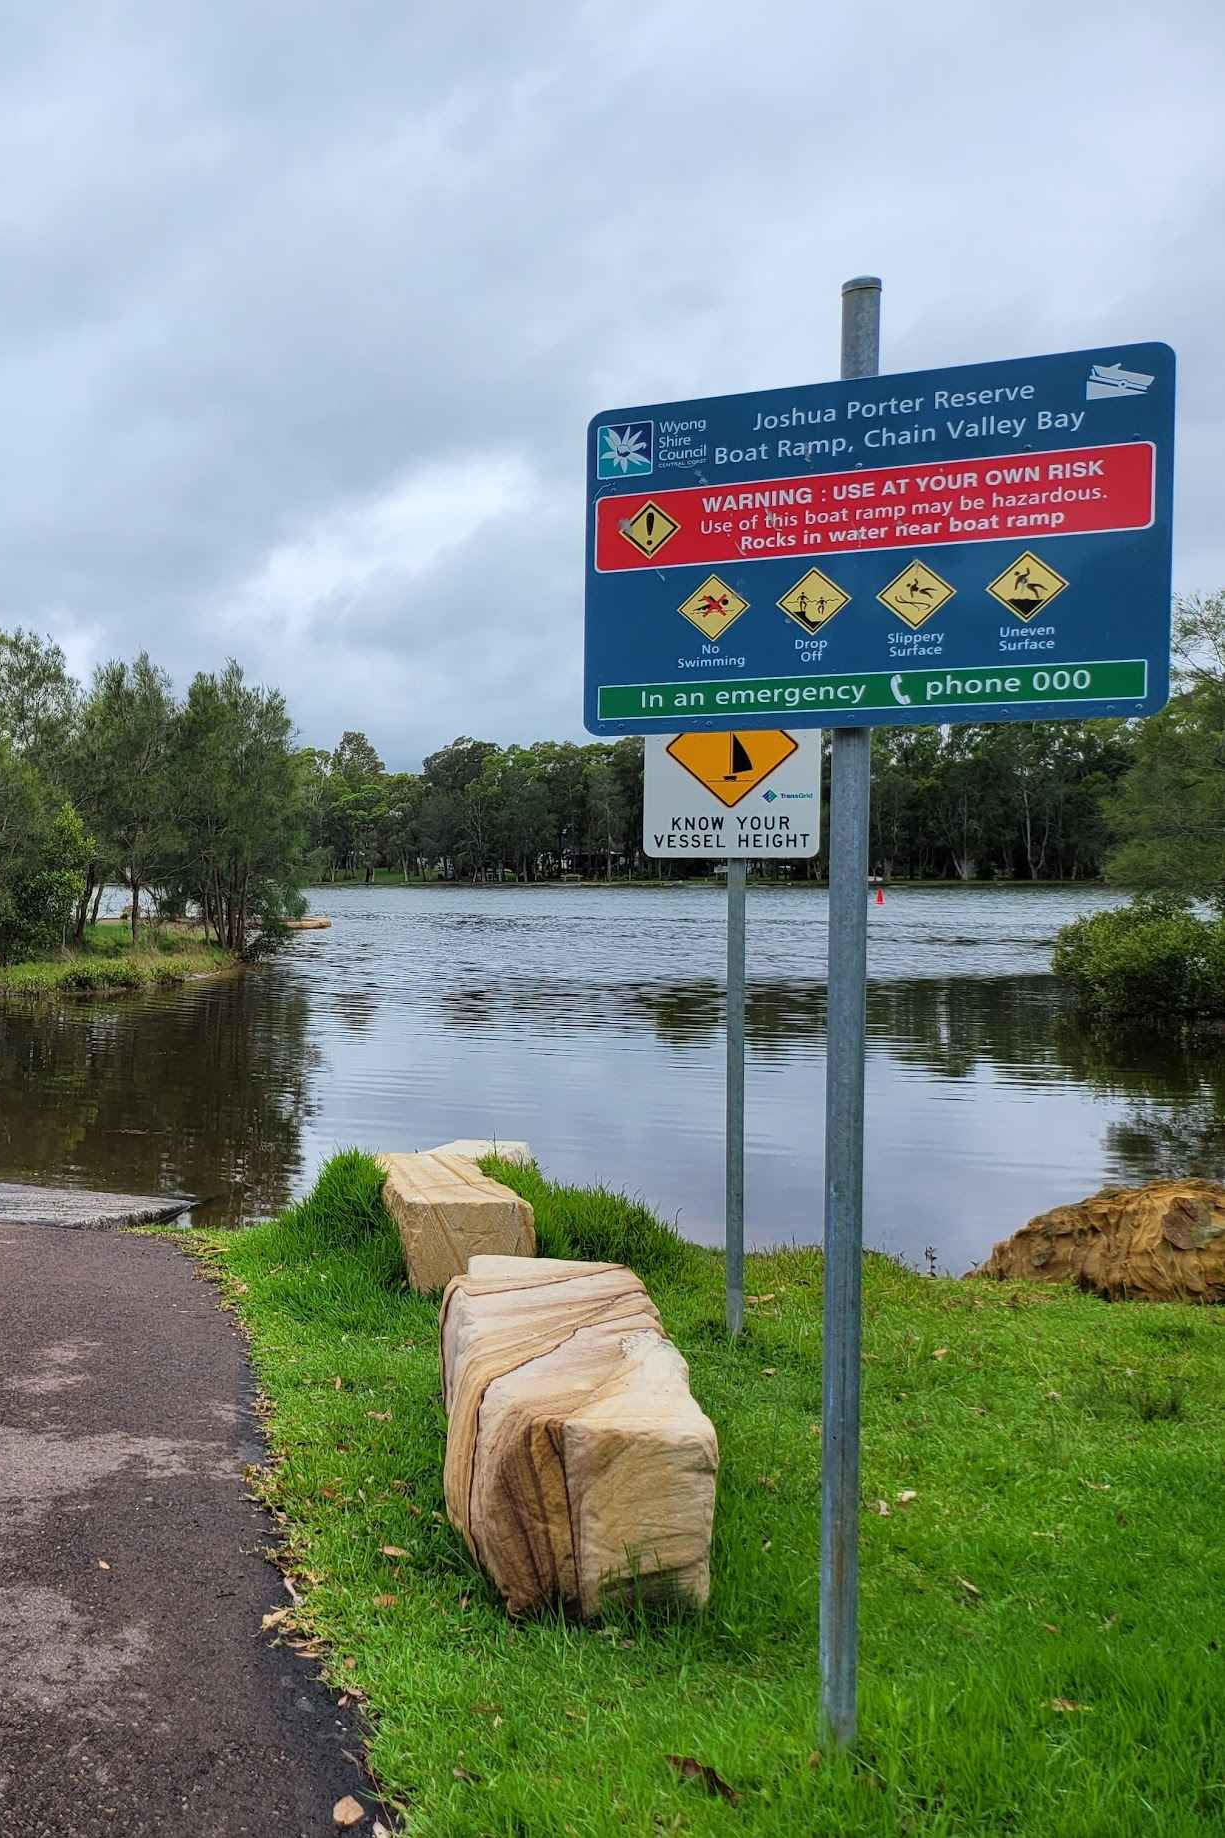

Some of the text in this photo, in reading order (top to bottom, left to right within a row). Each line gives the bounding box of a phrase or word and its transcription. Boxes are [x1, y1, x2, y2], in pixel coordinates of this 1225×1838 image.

[752, 384, 1035, 430] Joshua Porter Reserve
[658, 419, 707, 434] Wyong
[658, 435, 691, 448] Shire
[714, 410, 1085, 465] Boat Ramp, Chain Valley Bay
[658, 444, 707, 461] Council
[702, 487, 813, 513] WARNING
[832, 482, 876, 501] USE
[881, 479, 910, 496] AT
[915, 472, 978, 493] YOUR
[984, 466, 1040, 486] OWN
[1048, 459, 1105, 480] RISK
[700, 486, 1108, 535] Use of this boat ramp may be hazardous.
[740, 511, 1065, 550] Rocks in water near boat ramp
[886, 631, 945, 645] Slippery
[999, 625, 1055, 638] Uneven
[701, 644, 720, 655] No
[794, 638, 828, 650] Drop
[889, 644, 942, 657] Surface
[998, 639, 1055, 651] Surface
[677, 655, 746, 669] Swimming
[800, 651, 823, 663] Off
[640, 669, 1091, 709] In an emergency phone 000
[780, 792, 814, 800] TransGrid
[671, 816, 790, 831] KNOW YOUR
[653, 833, 811, 848] VESSEL HEIGHT
